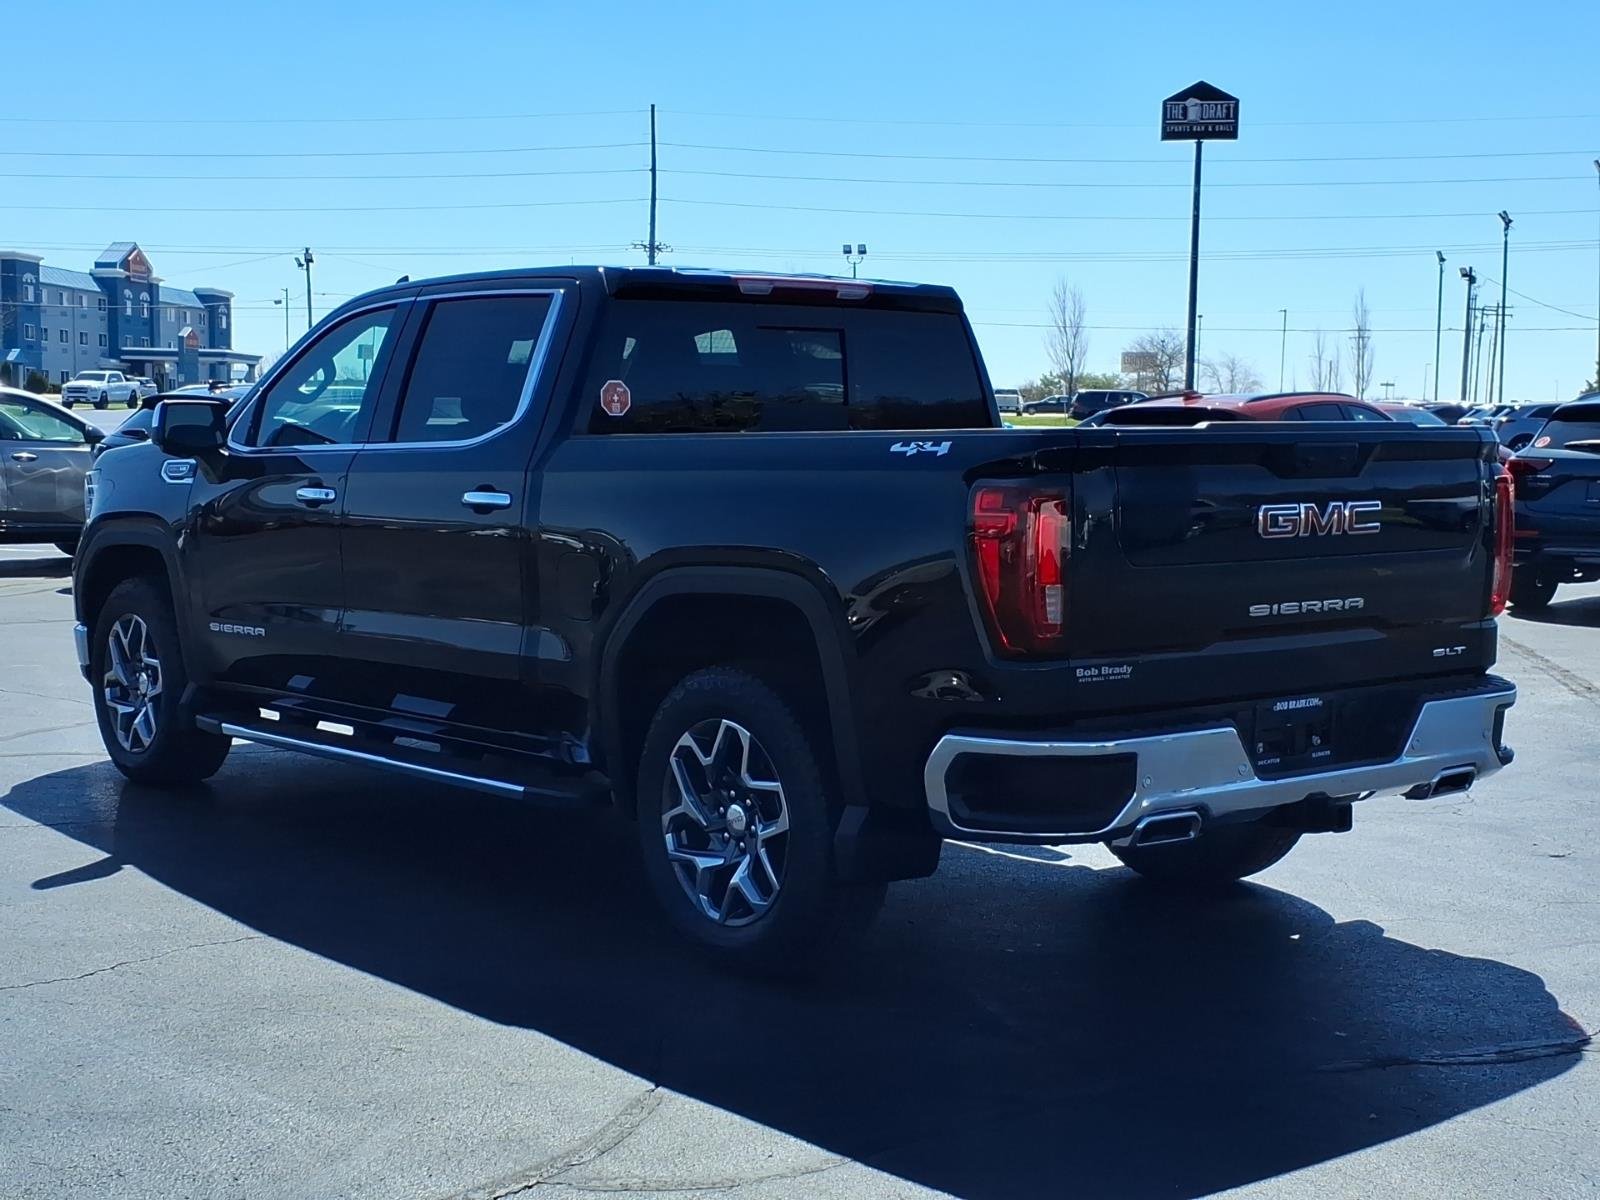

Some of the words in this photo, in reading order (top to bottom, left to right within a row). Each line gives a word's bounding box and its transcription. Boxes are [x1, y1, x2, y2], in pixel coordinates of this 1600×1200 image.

[1166, 104, 1185, 119] THE
[1202, 103, 1235, 119] DRAFT
[1258, 500, 1382, 539] GMC
[1249, 597, 1365, 617] SIERRA
[209, 622, 266, 637] SIERRA
[1432, 645, 1467, 657] SLT
[1076, 667, 1099, 677] Bob
[1101, 664, 1133, 675] Brady
